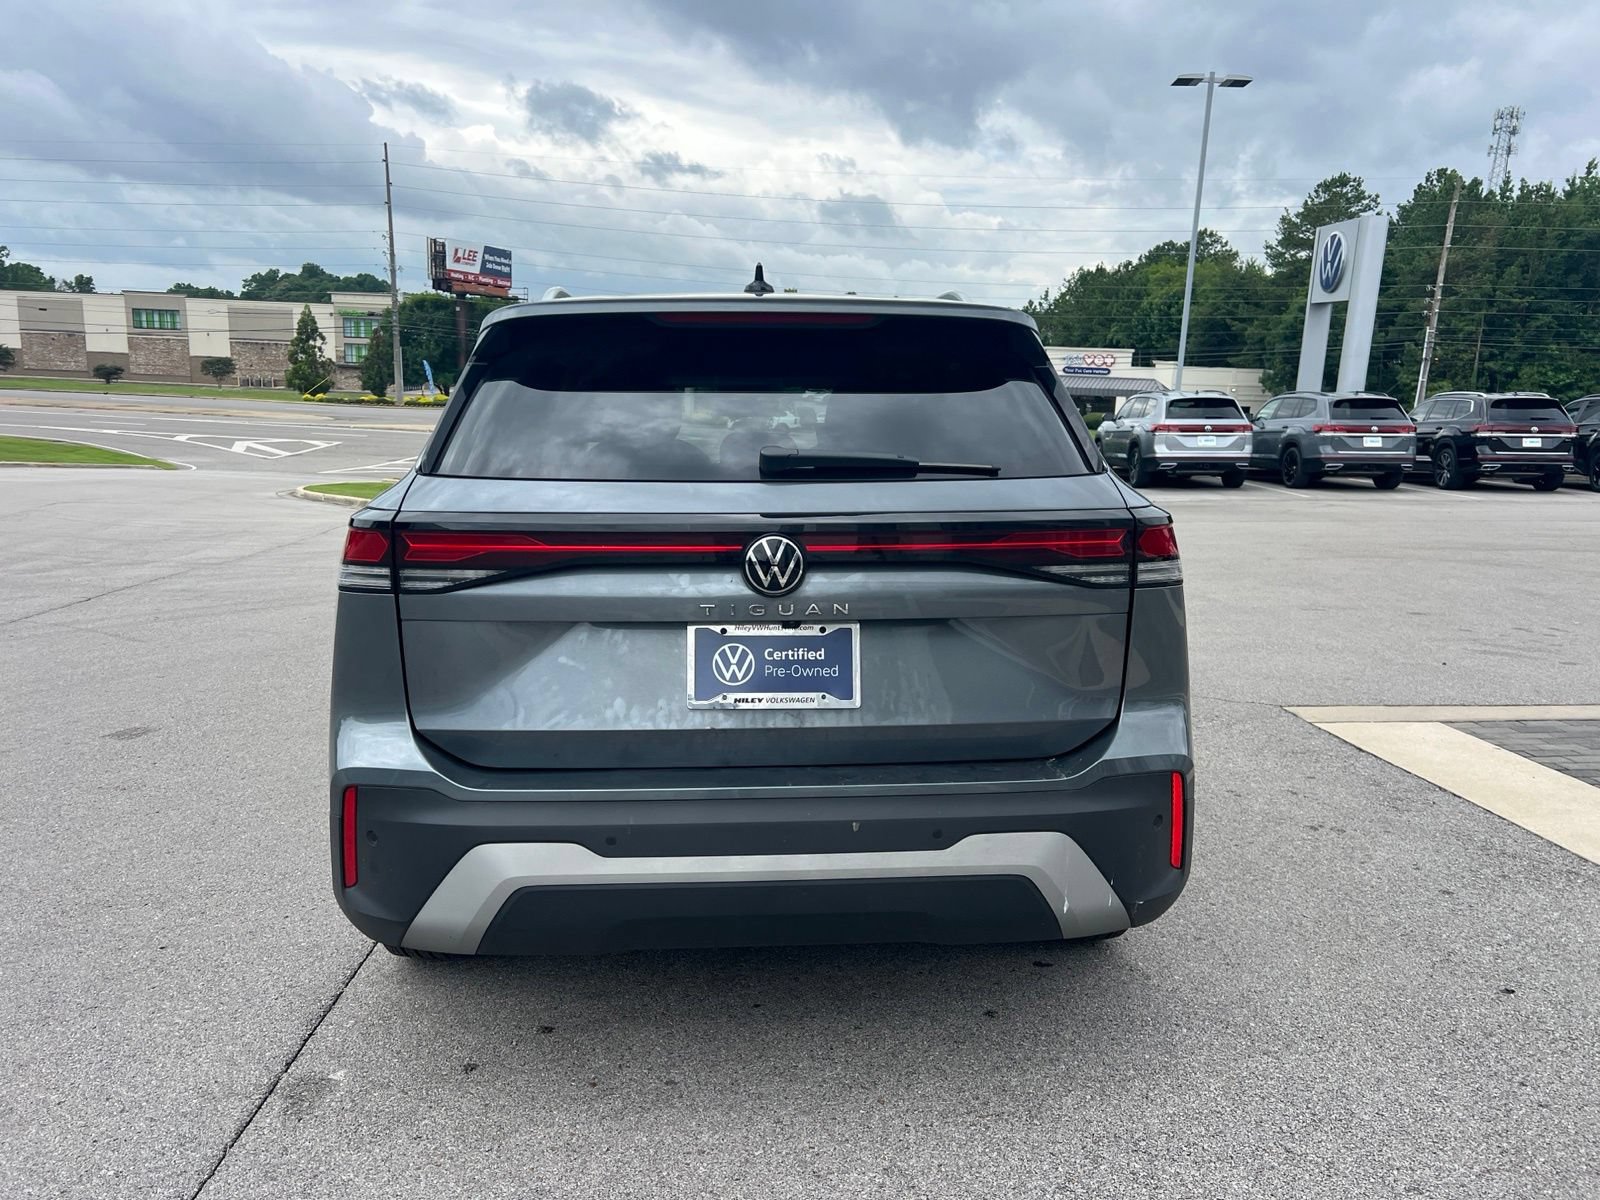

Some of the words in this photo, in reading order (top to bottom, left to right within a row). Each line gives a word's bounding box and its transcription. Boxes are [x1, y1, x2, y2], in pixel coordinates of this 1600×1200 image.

[462, 249, 478, 262] LEE
[502, 264, 511, 272] Right
[450, 272, 464, 280] Heating
[479, 276, 493, 284] Plumbing
[699, 603, 849, 616] TIGUAN
[764, 648, 825, 661] Certified
[765, 664, 839, 677] Pre-Owned
[765, 696, 815, 704] VOLKSWAGEN
